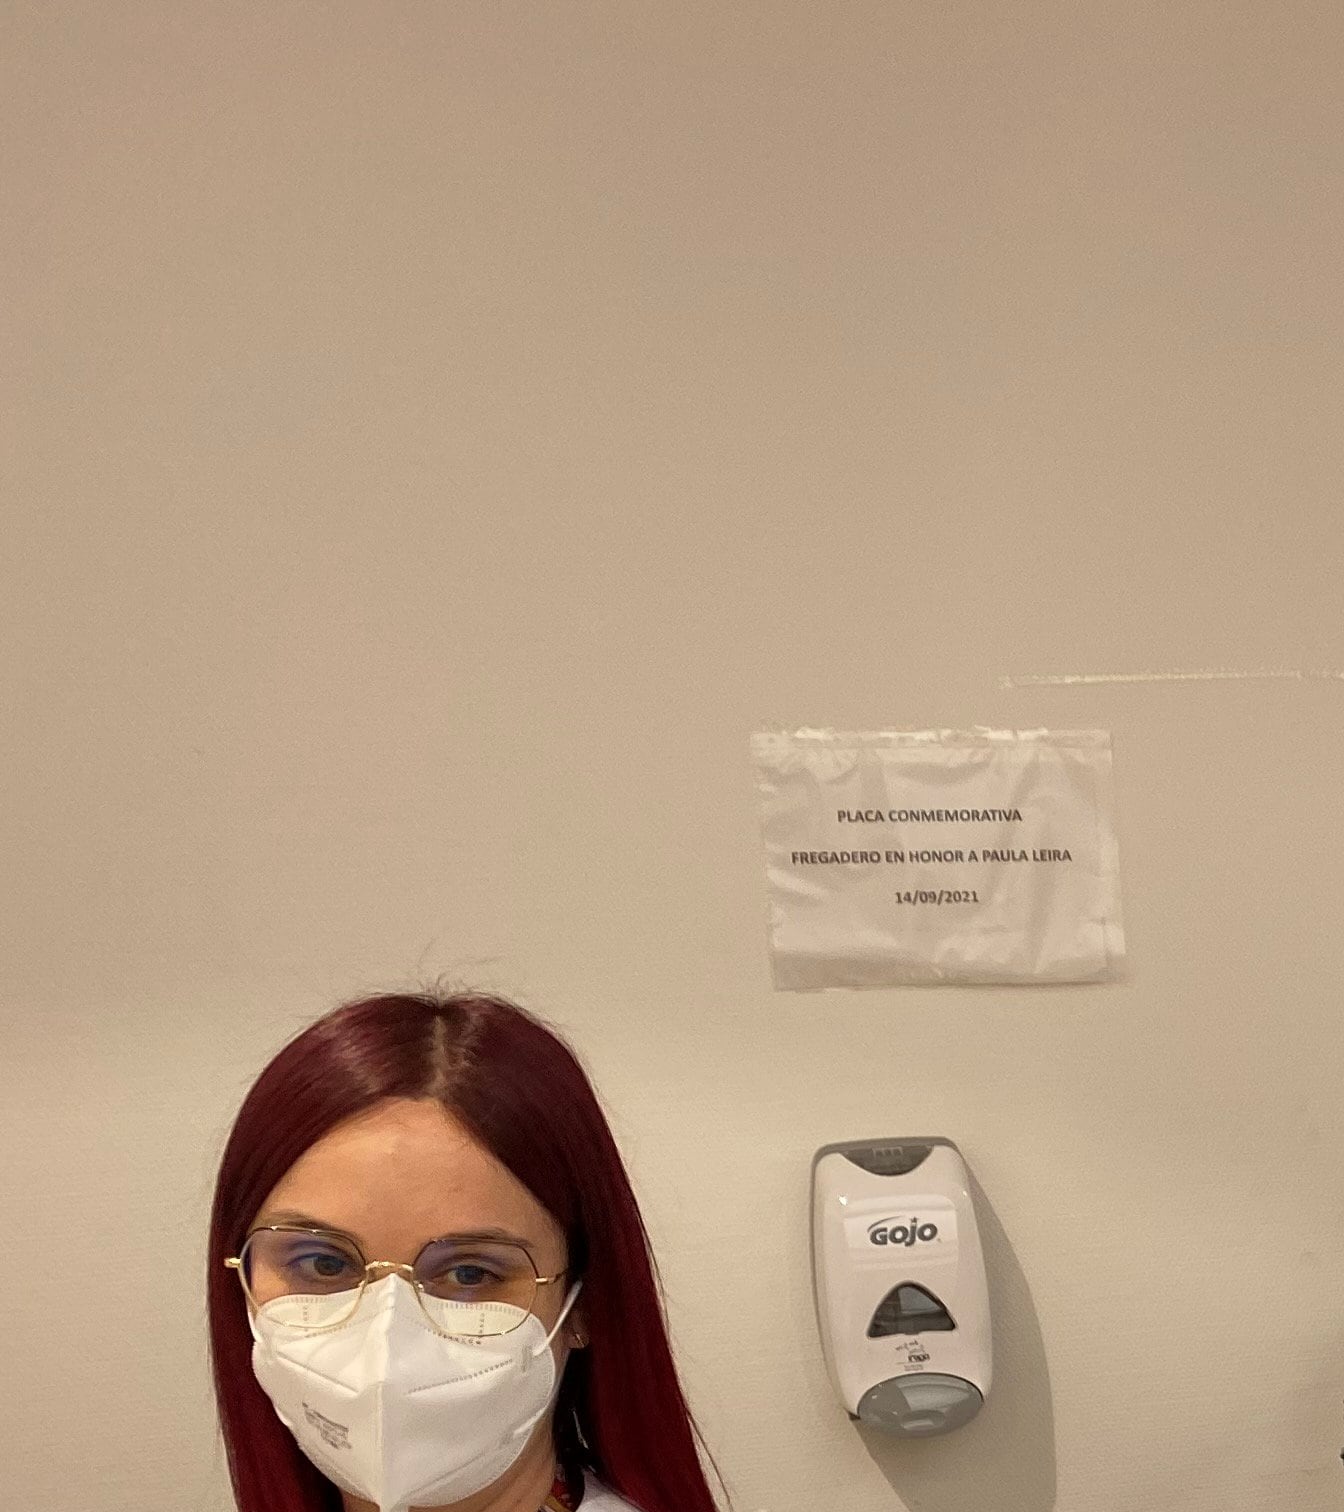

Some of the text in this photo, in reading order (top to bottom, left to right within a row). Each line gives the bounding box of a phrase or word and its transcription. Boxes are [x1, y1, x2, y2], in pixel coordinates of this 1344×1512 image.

[837, 808, 1023, 824] PLACA CONMEMORATIVA
[791, 848, 1072, 865] FREGADERO EN HONOR A PAULA LEIRA
[894, 890, 979, 906] 14/09/2021
